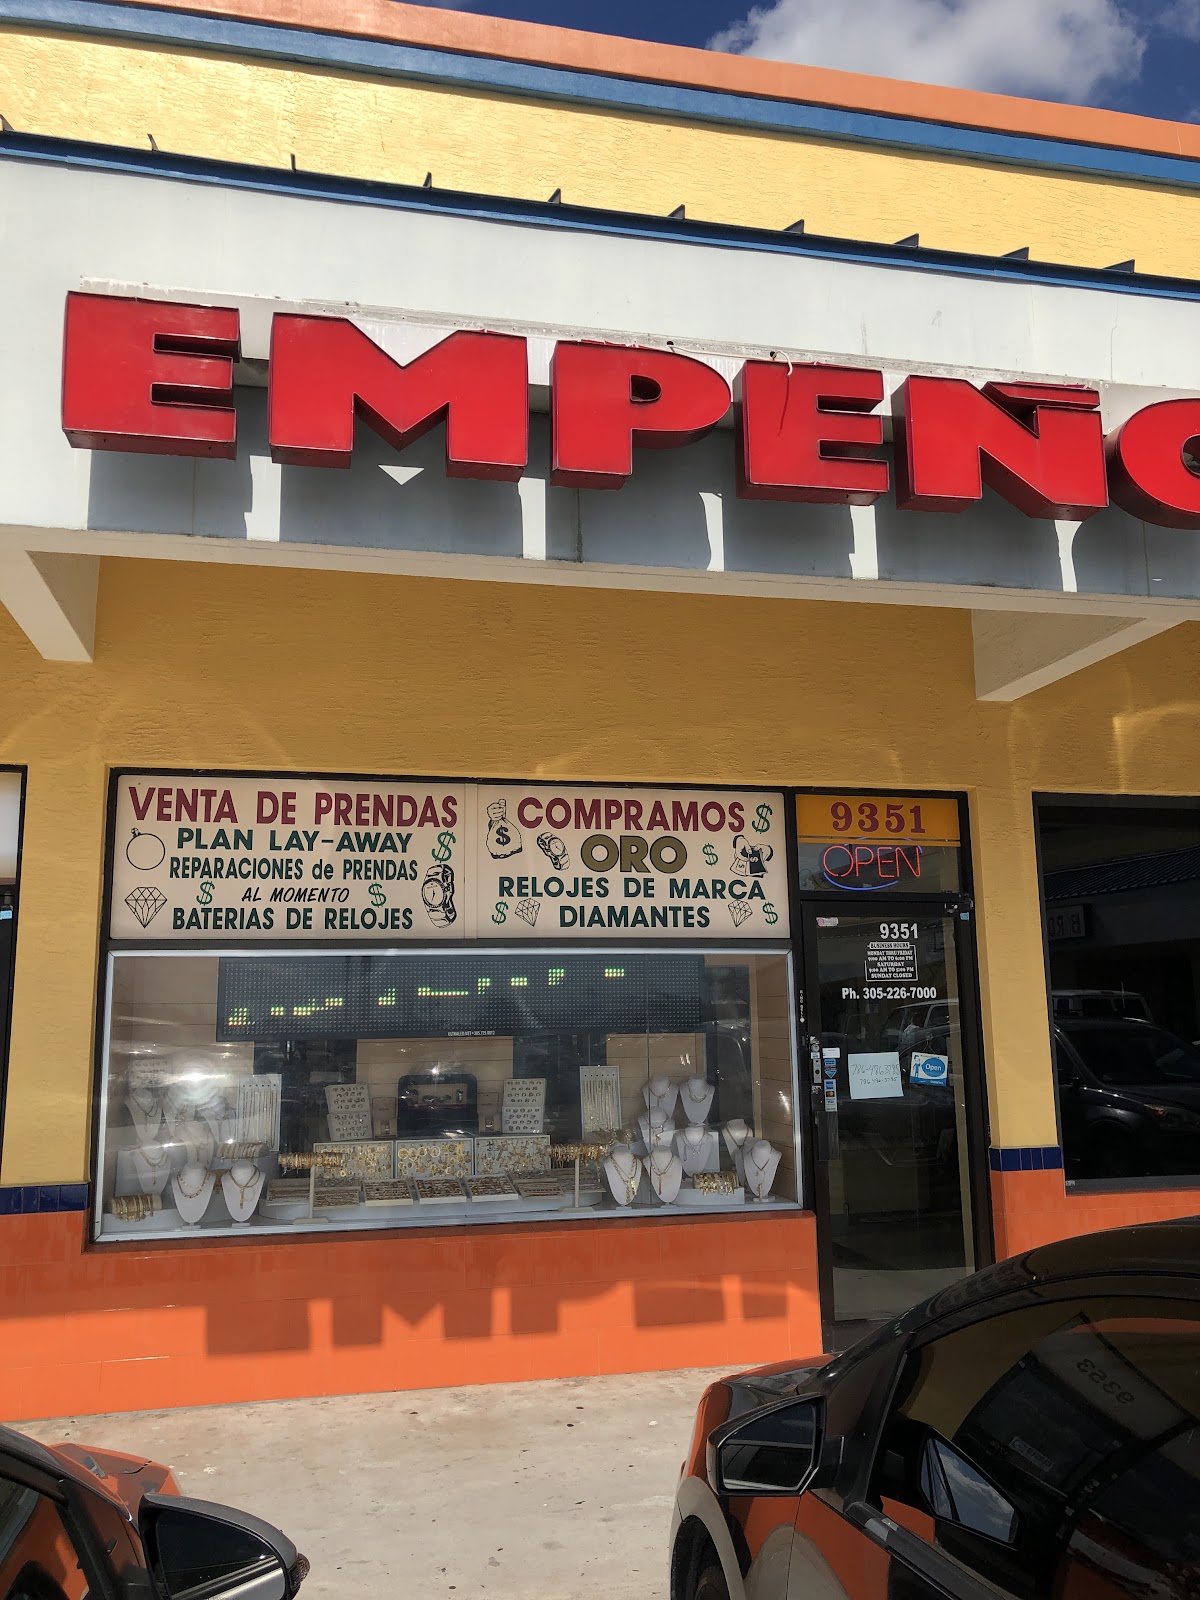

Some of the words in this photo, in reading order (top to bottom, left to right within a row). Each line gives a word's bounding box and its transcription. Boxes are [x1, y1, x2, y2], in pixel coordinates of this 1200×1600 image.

[129, 786, 239, 824] VENTA
[257, 791, 296, 825] DE
[315, 793, 458, 828] PRENDAS
[517, 797, 745, 832] COMPRAMOS
[831, 802, 926, 834] 9351
[177, 828, 253, 850] PLAN
[270, 830, 413, 854] LAY-AWAY
[580, 834, 688, 874] ORO
[823, 845, 921, 877] OPEN
[169, 857, 303, 880] REPARACIONES
[312, 859, 334, 880] de
[343, 859, 418, 881] PRENDAS
[241, 887, 262, 902] AL
[270, 887, 349, 903] MOMENTO
[499, 877, 609, 898] RELOJES
[624, 878, 655, 899] DE
[669, 879, 766, 901] MARCA
[172, 907, 274, 930] BATERIAS
[286, 908, 313, 930] DE
[325, 908, 413, 930] RELOJES
[559, 905, 710, 928] DIAMANTES
[879, 923, 918, 939] 9351
[841, 987, 860, 1000] Ph.
[862, 986, 937, 1000] 305-226-7000
[925, 1063, 942, 1072] Open
